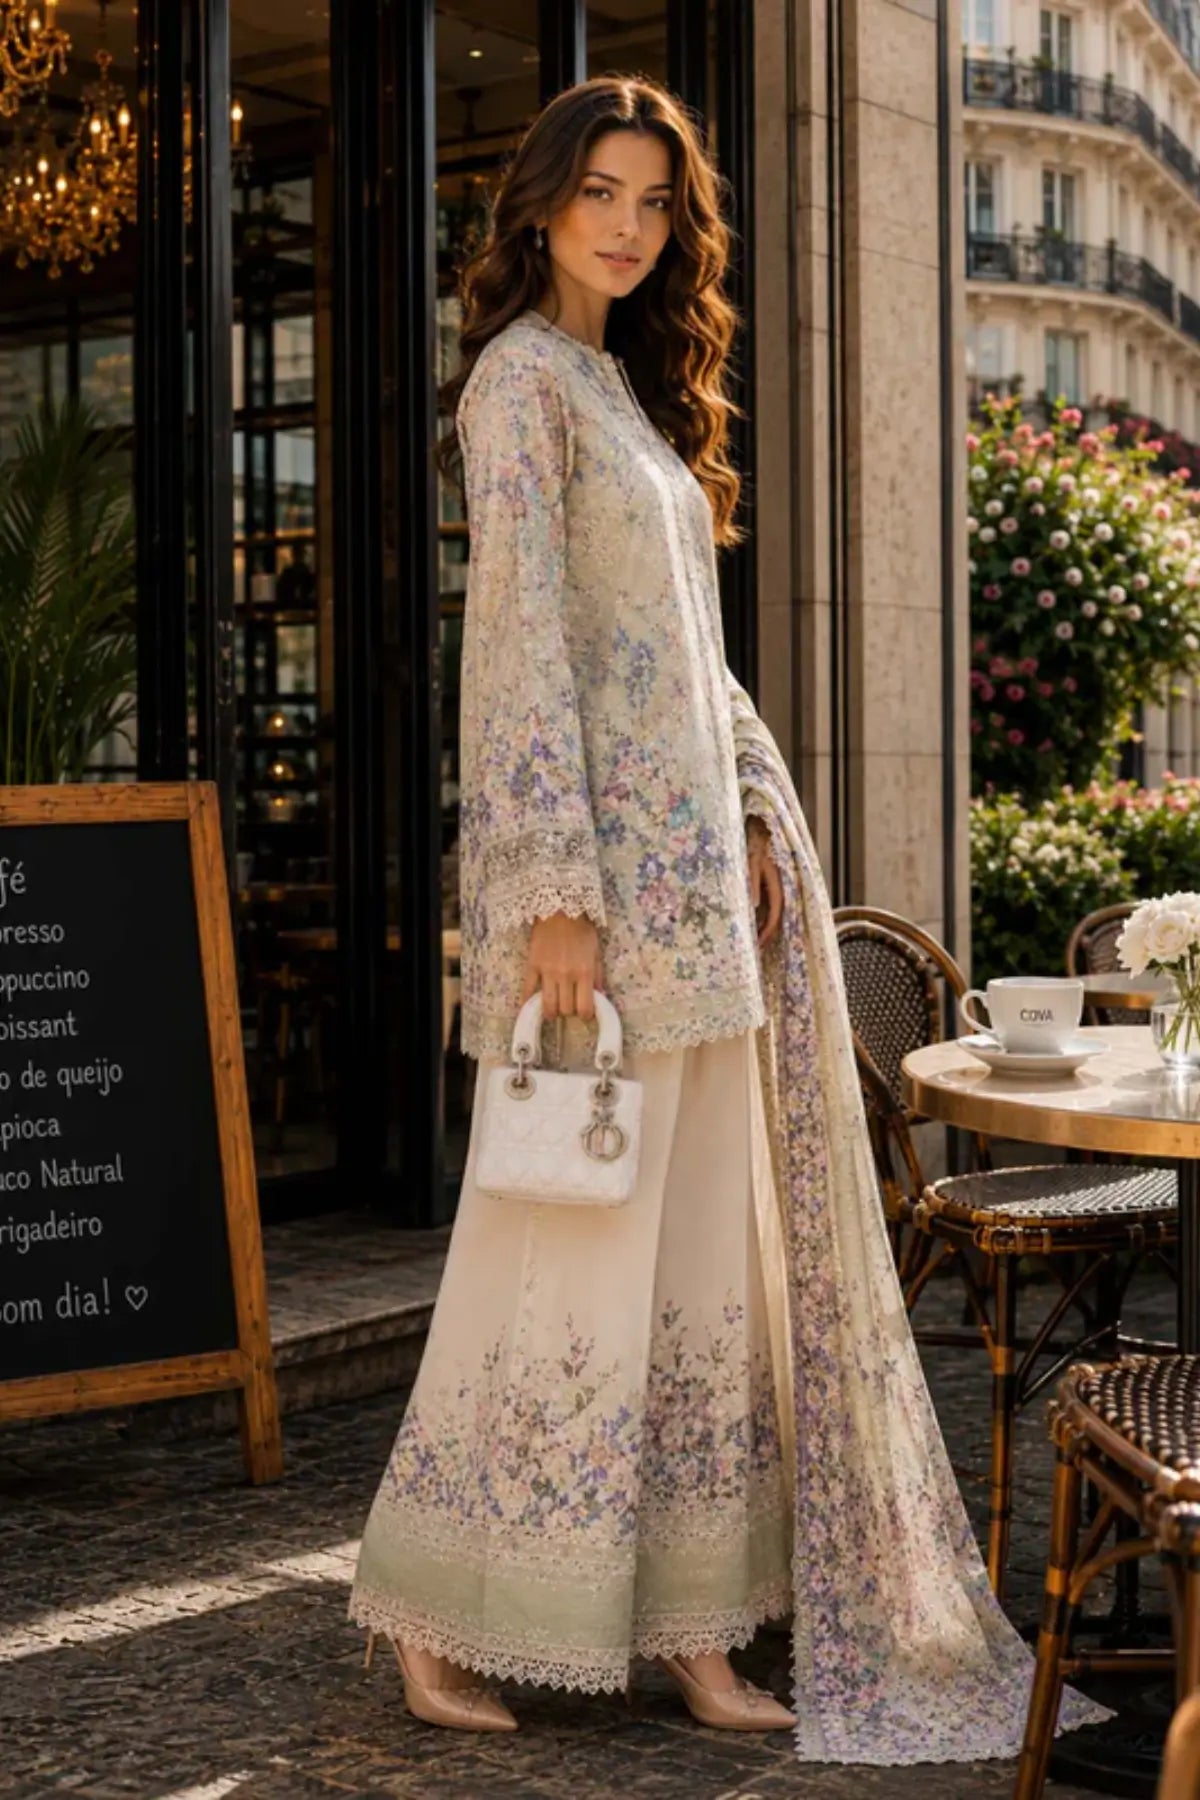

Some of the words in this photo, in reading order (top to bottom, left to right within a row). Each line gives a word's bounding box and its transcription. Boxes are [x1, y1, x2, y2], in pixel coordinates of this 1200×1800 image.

[0, 924, 65, 944] resso
[21, 1060, 47, 1088] de
[57, 1058, 123, 1098] queijo
[41, 1153, 123, 1188] Natural
[0, 1298, 43, 1324] om
[56, 1277, 111, 1319] dia!
